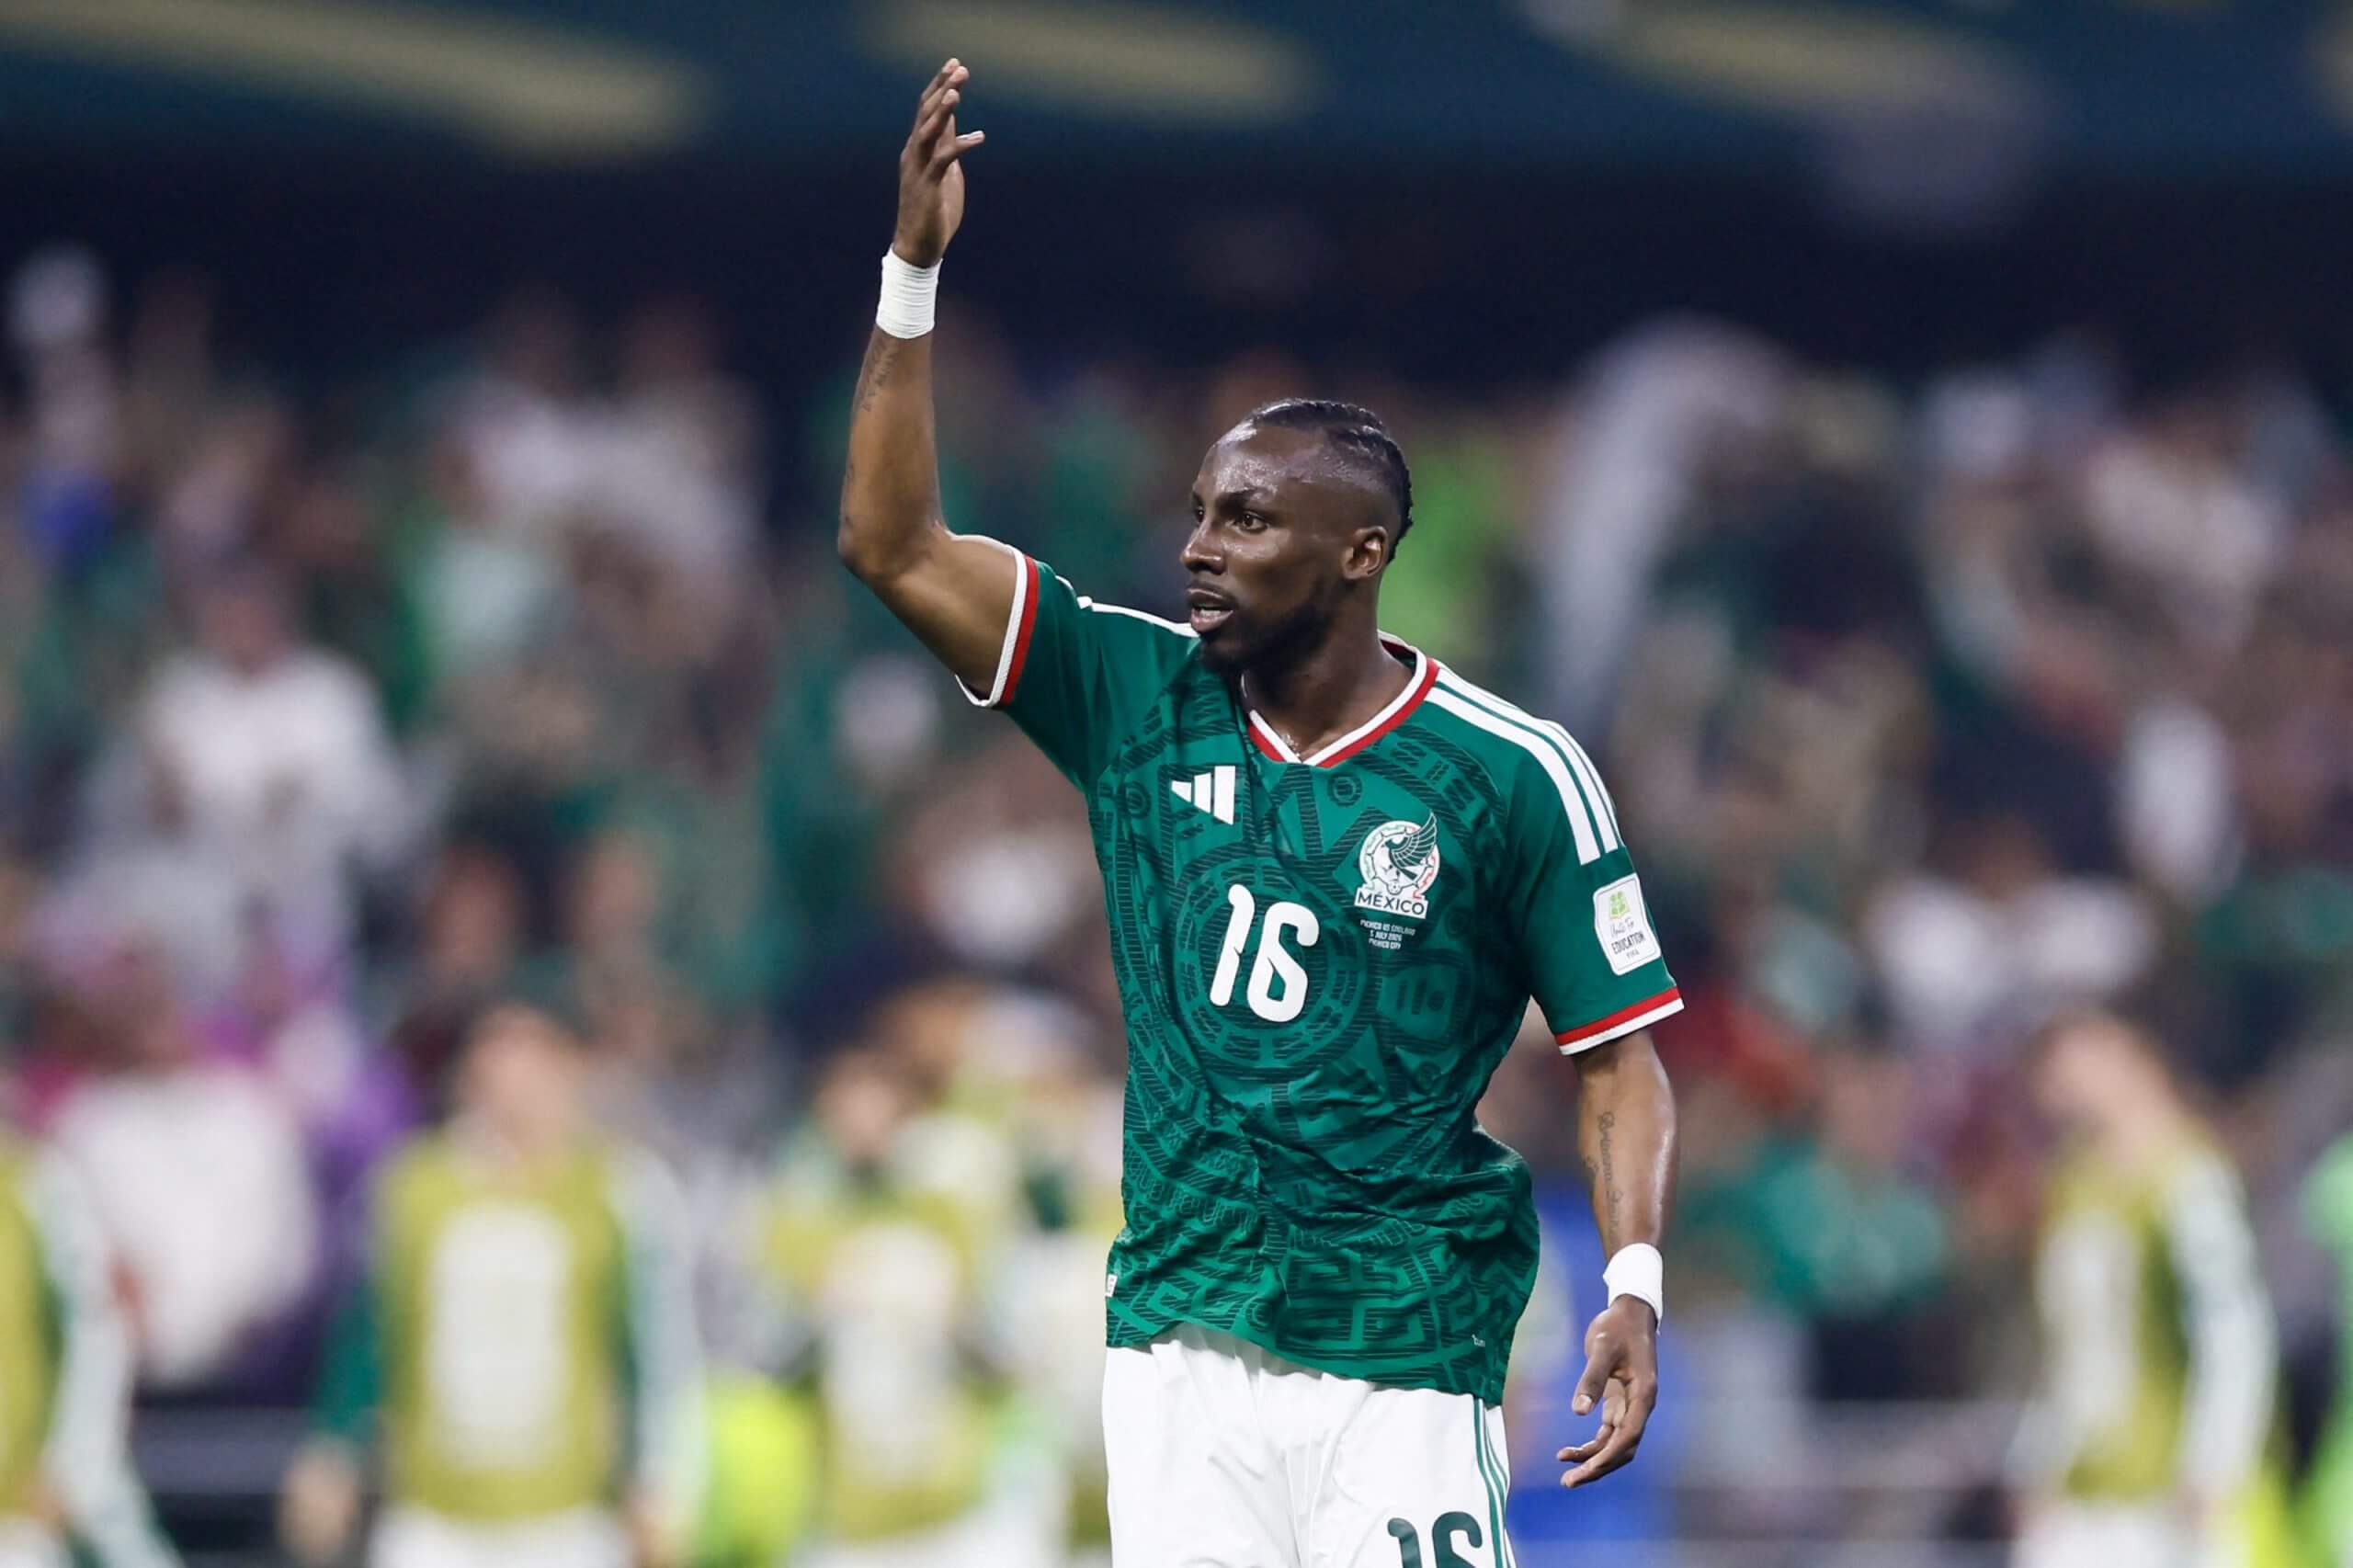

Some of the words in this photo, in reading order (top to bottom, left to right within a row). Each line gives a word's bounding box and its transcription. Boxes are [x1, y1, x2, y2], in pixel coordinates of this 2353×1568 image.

[1358, 891, 1425, 915] MÉXICO
[1210, 883, 1320, 1023] 16
[1610, 931, 1645, 955] EDUCATION
